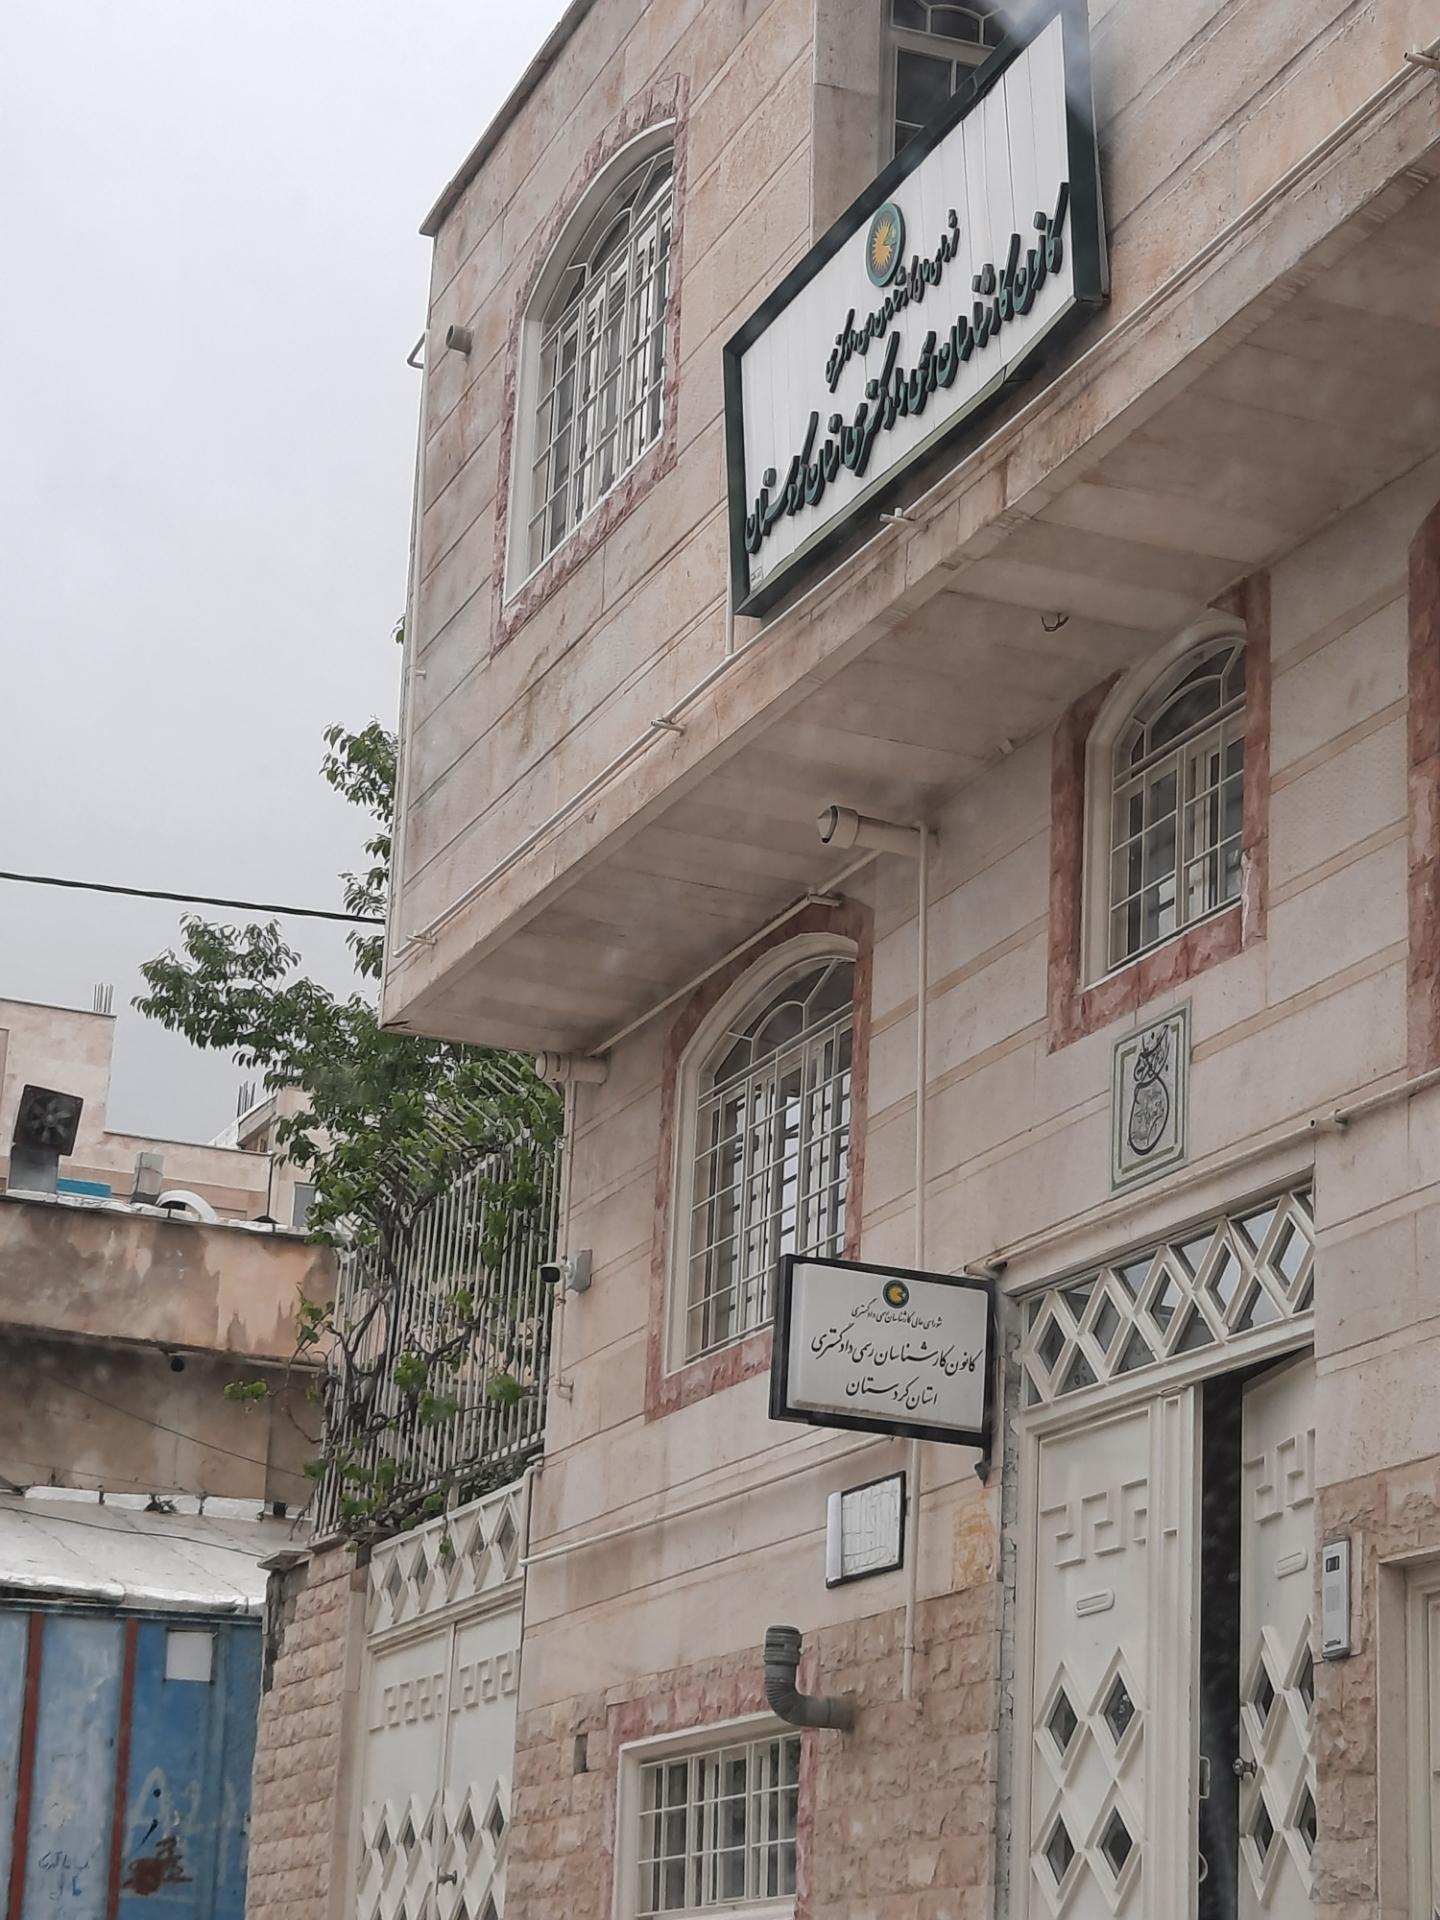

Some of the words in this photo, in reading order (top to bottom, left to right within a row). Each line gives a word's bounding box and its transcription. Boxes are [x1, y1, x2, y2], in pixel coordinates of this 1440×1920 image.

[930, 209, 960, 287] شورای
[1013, 182, 1069, 315] کانون
[874, 255, 919, 338] کارشناسان
[937, 233, 1021, 388] کارشناسان
[825, 308, 858, 393] دادگستری
[857, 312, 875, 356] رسمی
[908, 331, 938, 415] رسمی
[840, 331, 908, 477] دادگستری
[804, 414, 846, 506] استان
[745, 411, 819, 554] کردستان
[851, 1298, 877, 1318] دادگستری
[884, 1311, 915, 1324] کارشناسان
[911, 1317, 923, 1328] عالی
[923, 1316, 943, 1330] شورای
[811, 1323, 854, 1360] دادگستری
[852, 1342, 874, 1363] رسمی
[873, 1341, 955, 1367] کارشناسان
[944, 1349, 983, 1376] کانون
[845, 1376, 920, 1402] کردستان
[905, 1386, 939, 1410] استان
